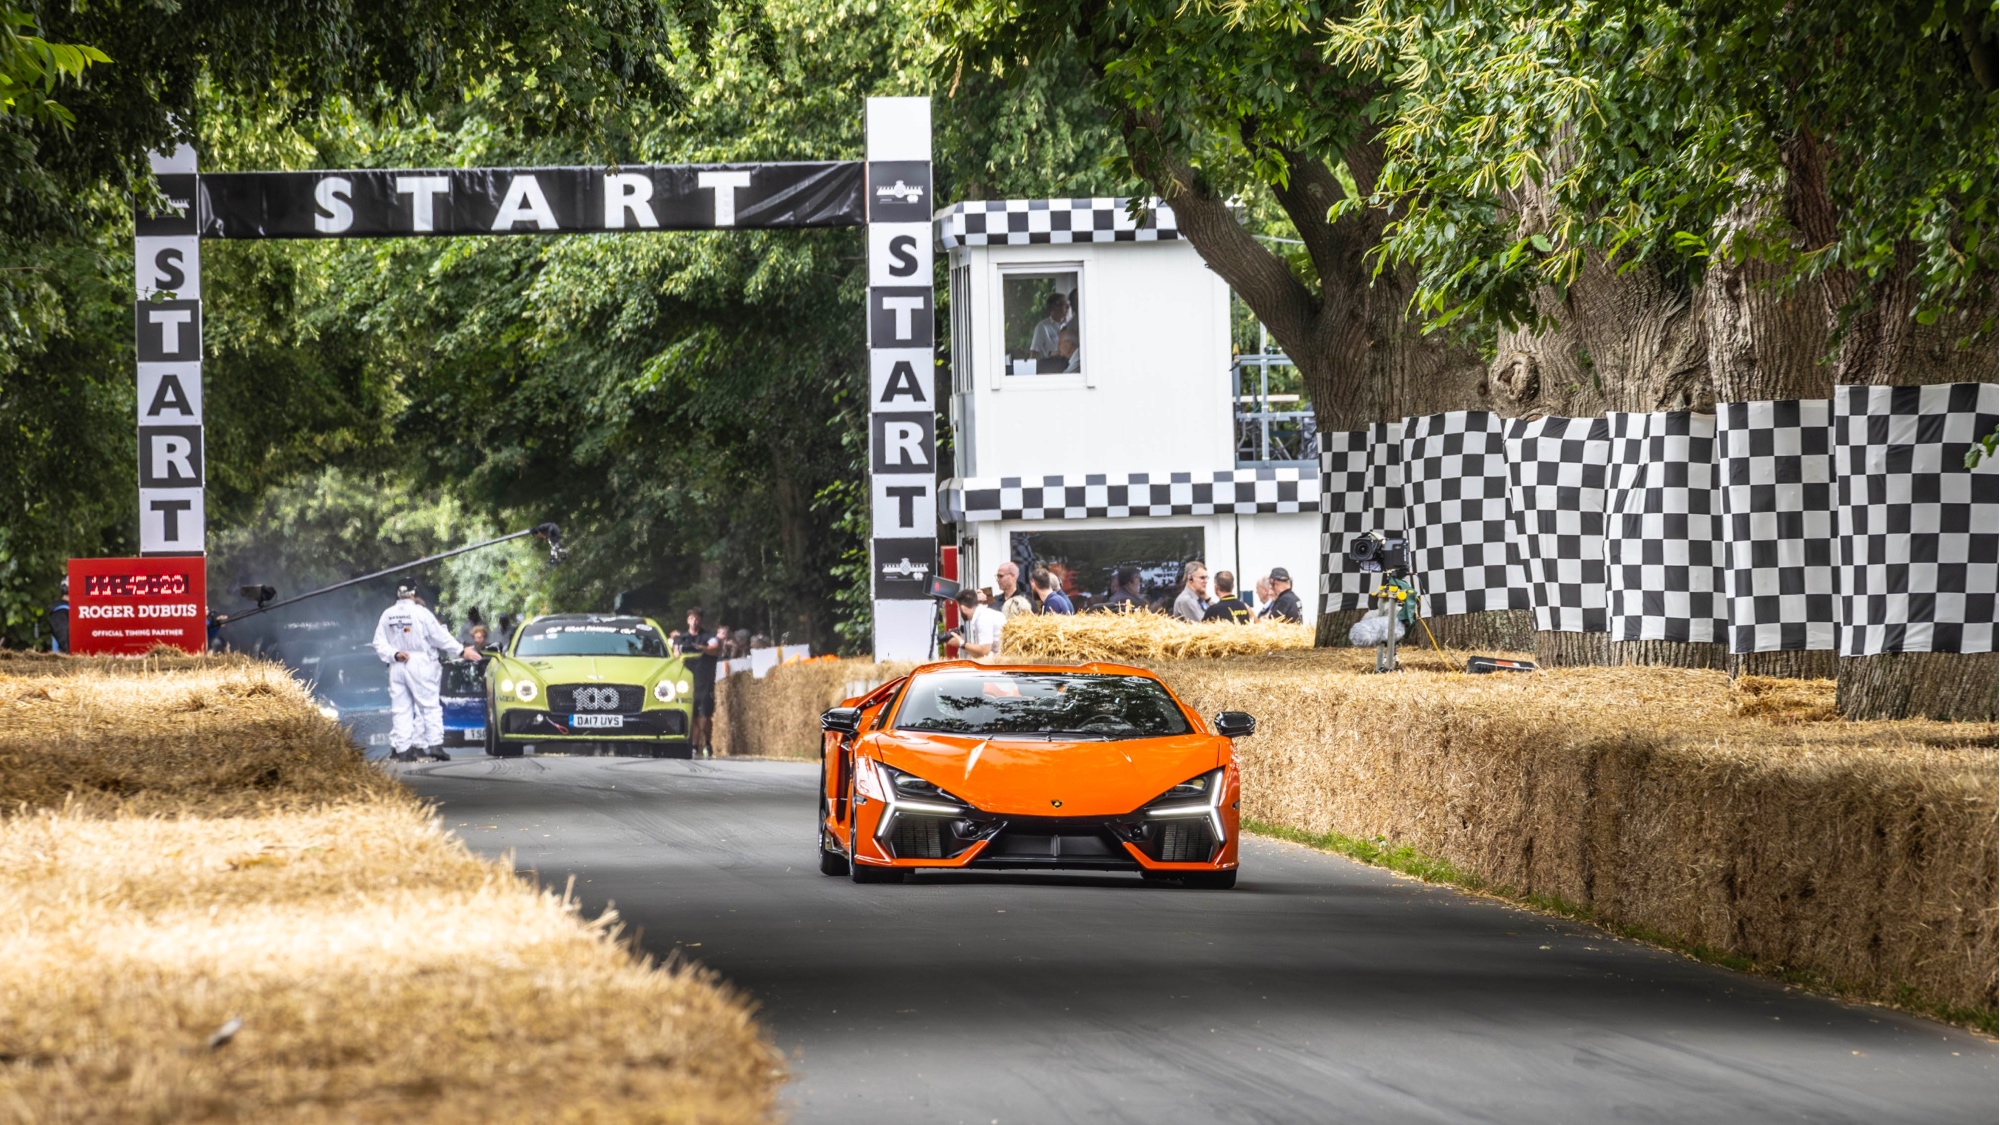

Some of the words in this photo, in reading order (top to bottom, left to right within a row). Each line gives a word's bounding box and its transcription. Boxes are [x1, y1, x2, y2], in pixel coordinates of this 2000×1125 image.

[314, 170, 751, 233] START
[880, 234, 929, 528] START
[146, 247, 197, 542] START
[90, 574, 185, 595] 11:45:20
[78, 605, 135, 618] ROGER
[138, 604, 197, 617] DUBUIS
[91, 629, 123, 637] OFFICIAL
[125, 629, 151, 637] TIMING
[152, 628, 183, 636] PARTNER
[573, 687, 620, 711] 100
[577, 716, 598, 726] DA17
[601, 716, 620, 726] UVS
